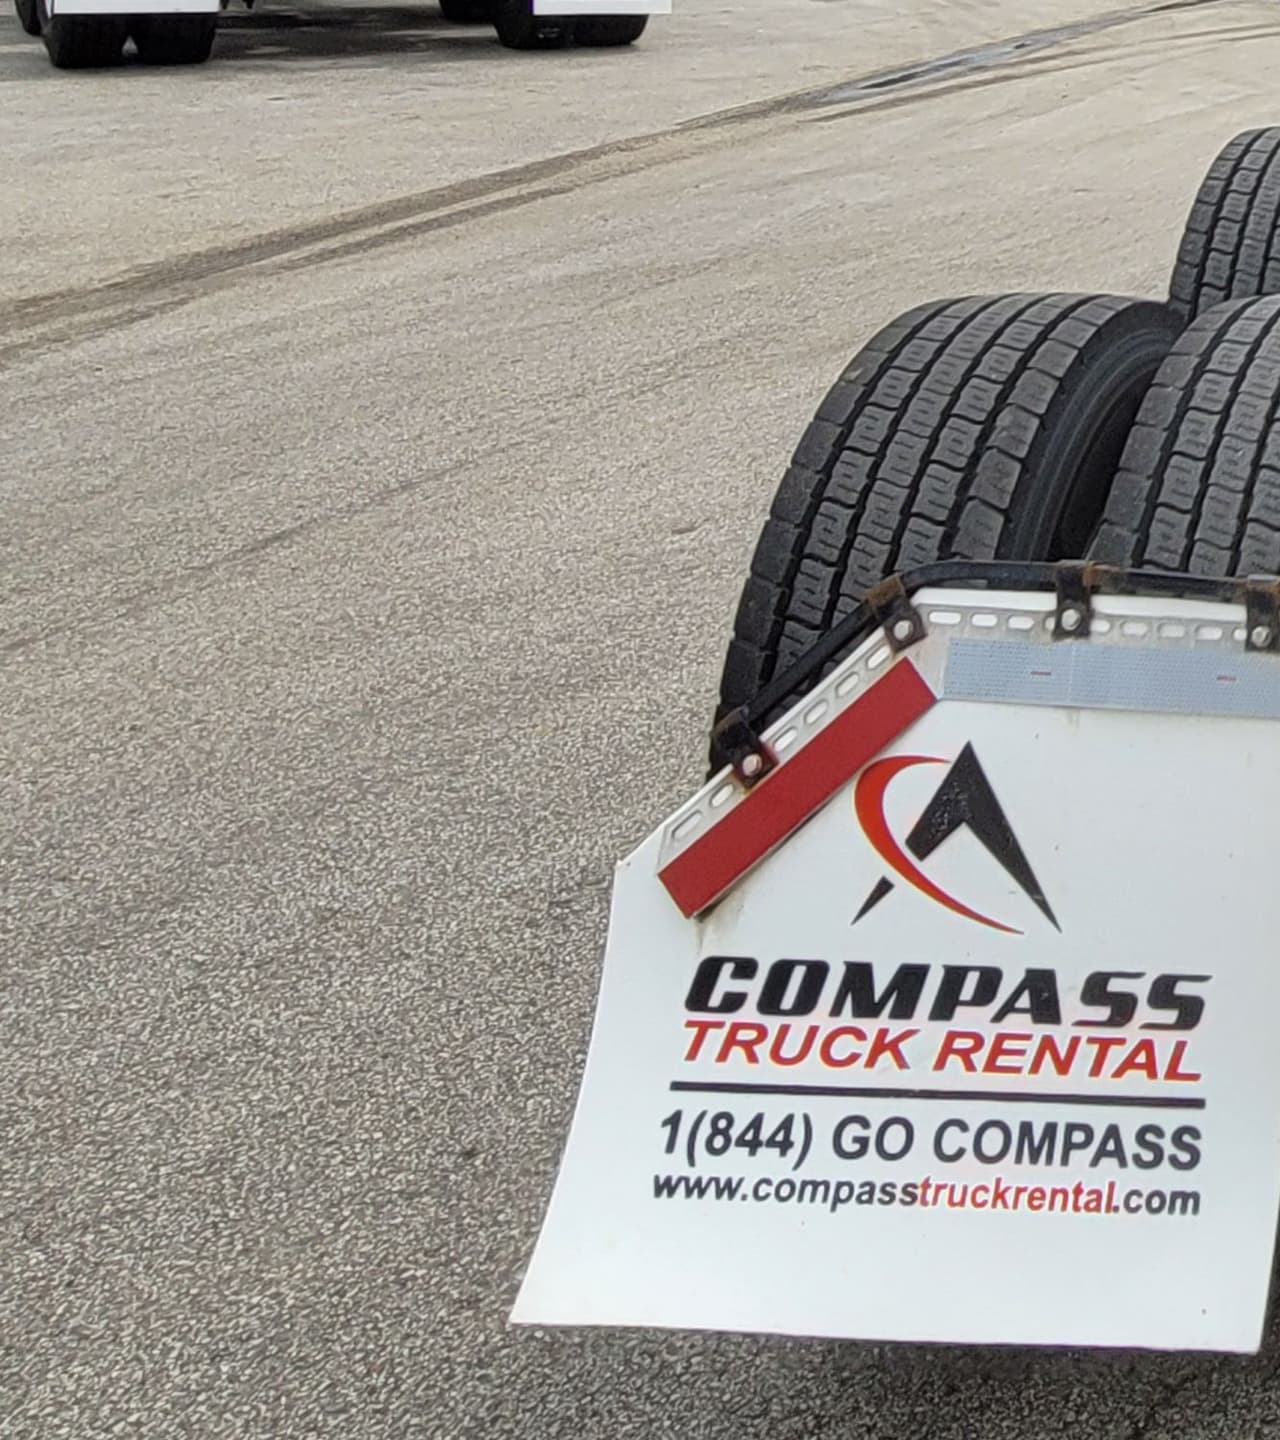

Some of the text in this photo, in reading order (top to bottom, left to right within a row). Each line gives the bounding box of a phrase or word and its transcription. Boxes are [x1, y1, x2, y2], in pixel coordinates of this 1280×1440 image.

[684, 955, 1212, 1031] COMPASS
[683, 1020, 1203, 1082] TRUCK RENTAL
[659, 1110, 1202, 1171] 1(844) GO COMPASS
[652, 1172, 1201, 1217] www.compasstruckrental.com
